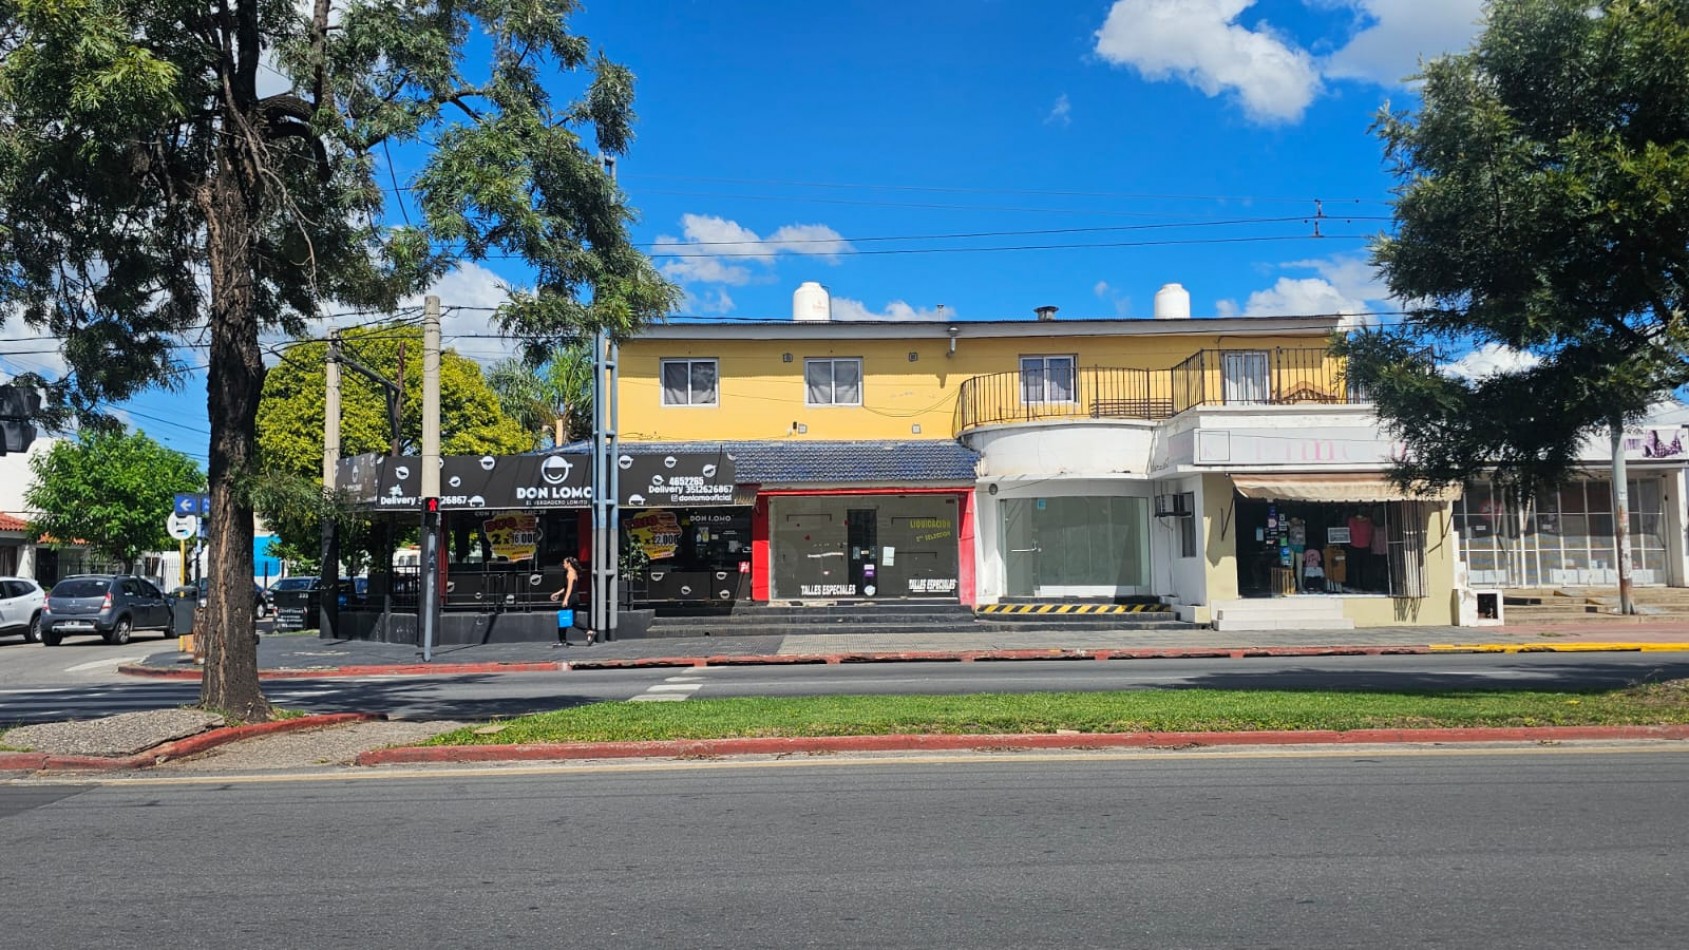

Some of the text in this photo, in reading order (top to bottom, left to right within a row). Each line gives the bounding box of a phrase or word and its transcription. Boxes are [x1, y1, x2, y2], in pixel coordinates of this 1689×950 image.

[516, 487, 549, 499] DON
[648, 484, 734, 495] Delivery 3512626867
[380, 496, 416, 506] Delivery
[800, 584, 856, 596] TALLES ESPECIALES
